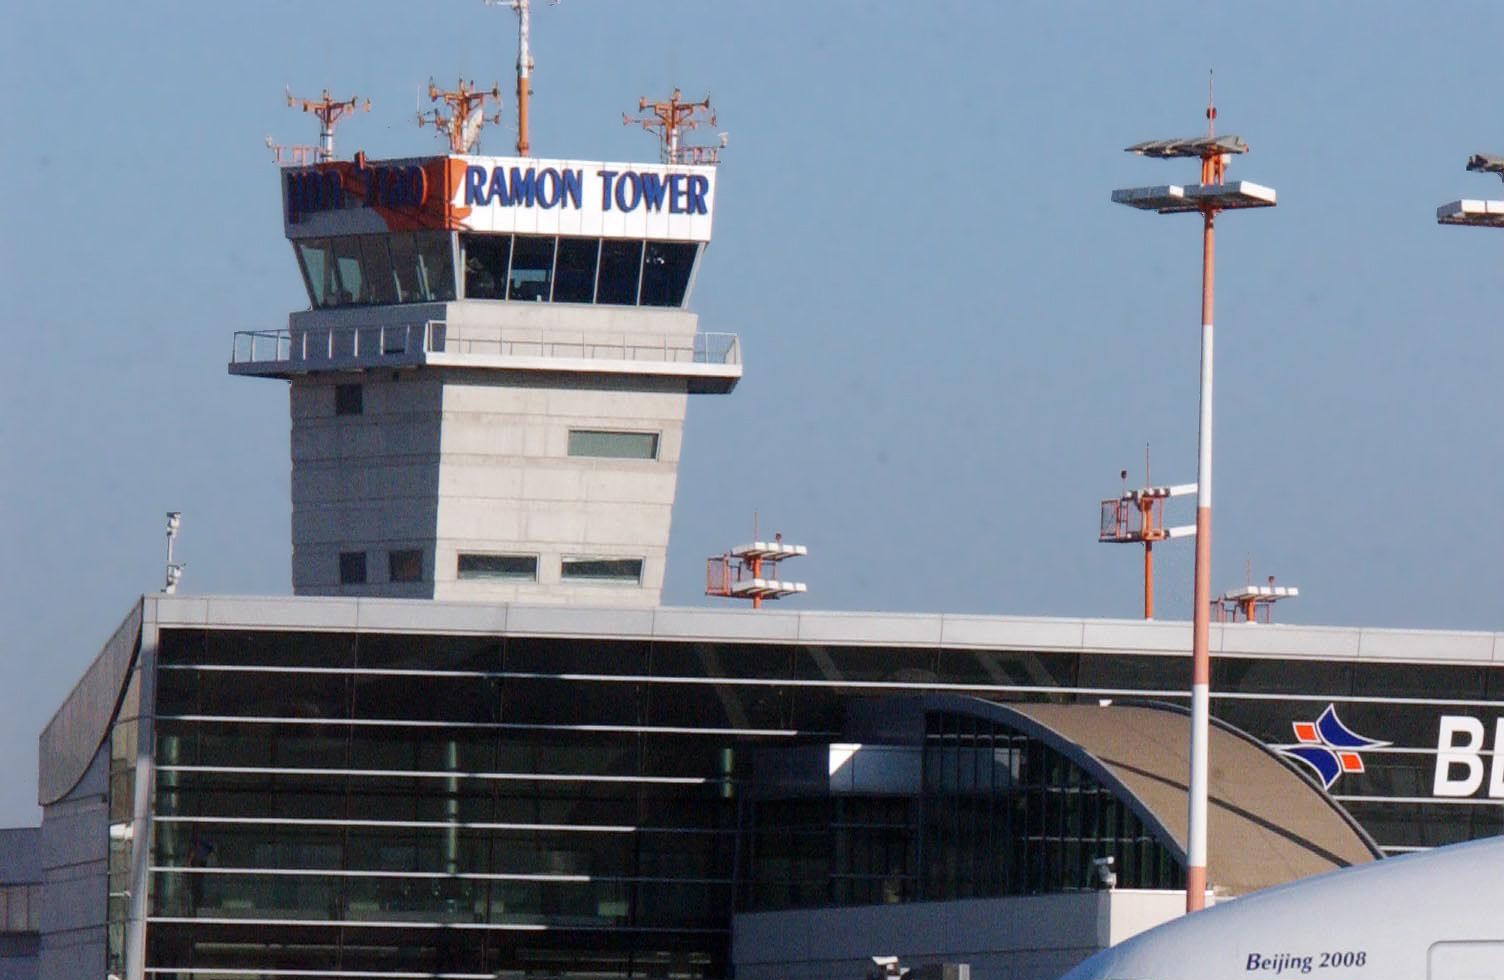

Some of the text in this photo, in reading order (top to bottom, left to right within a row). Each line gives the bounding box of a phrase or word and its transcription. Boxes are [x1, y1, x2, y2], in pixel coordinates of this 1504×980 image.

[465, 165, 710, 216] RAMON TOWER
[1246, 951, 1367, 974] Beijing 2008
